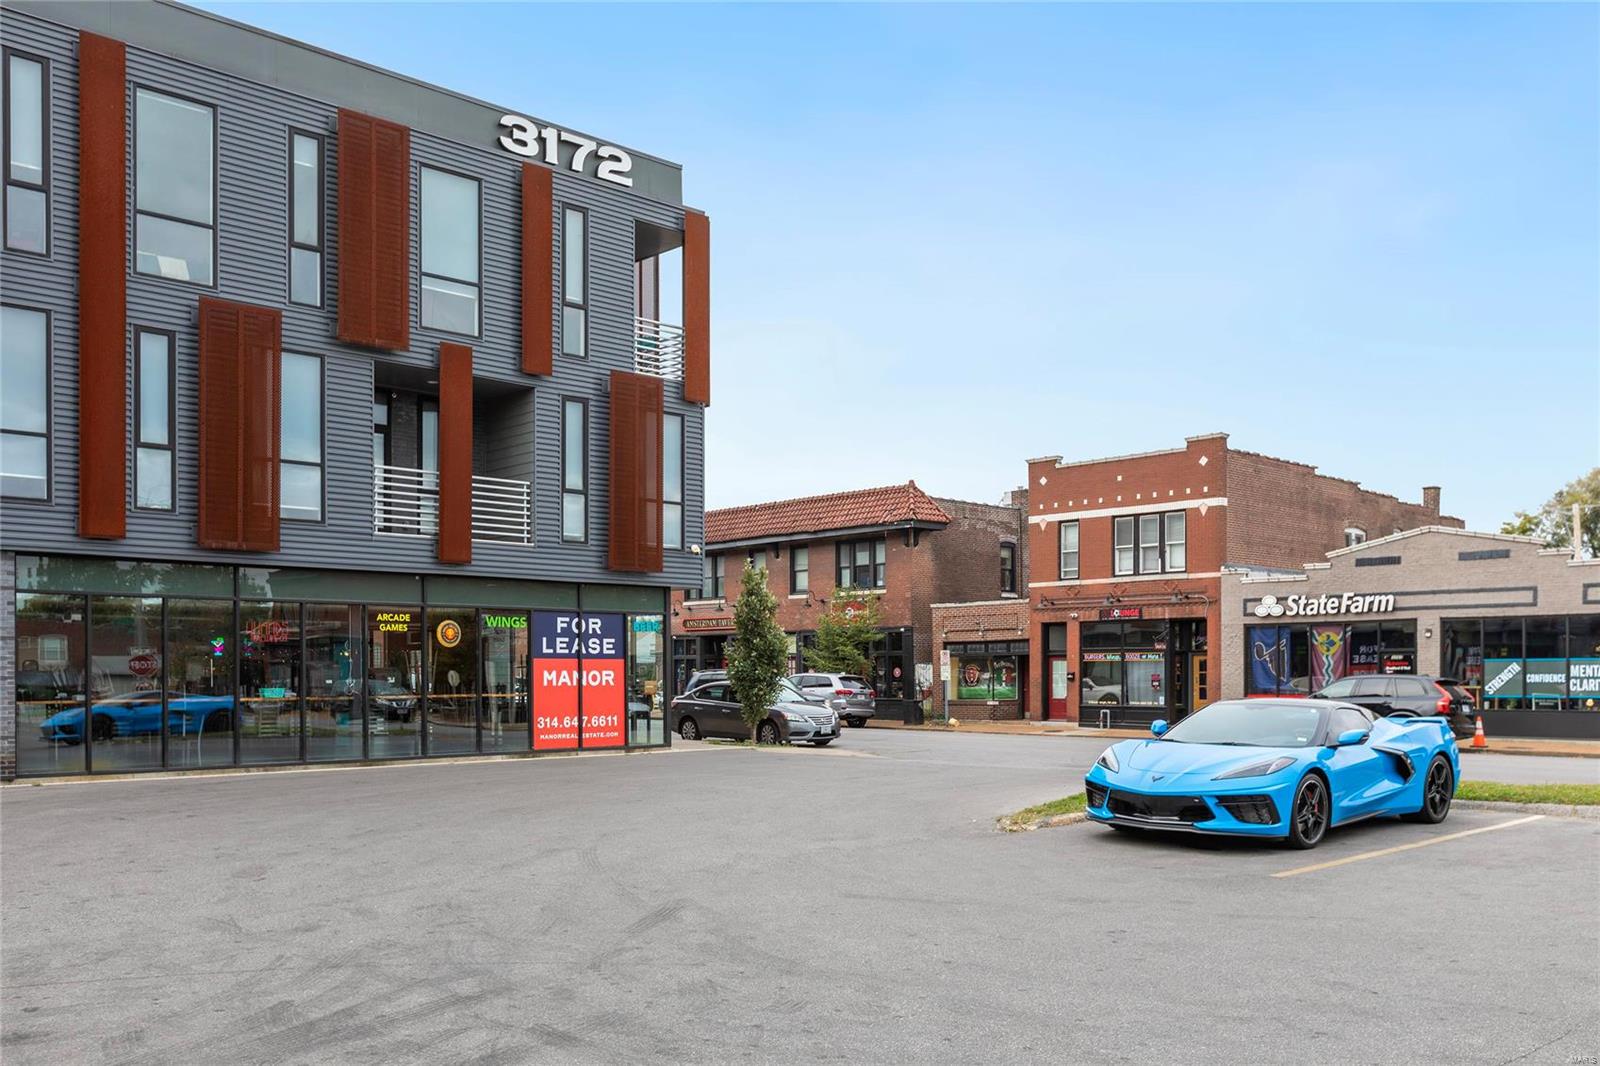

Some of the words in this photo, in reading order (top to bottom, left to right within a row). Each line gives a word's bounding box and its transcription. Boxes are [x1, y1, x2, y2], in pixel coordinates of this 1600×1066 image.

[499, 113, 633, 188] 3172
[376, 612, 411, 622] ARCADE
[485, 614, 528, 628] WINGS
[717, 617, 737, 627] TAVER
[379, 623, 408, 632] GAMES
[556, 616, 603, 635] FOR
[542, 636, 616, 655] LEASE
[543, 669, 615, 687] MANOR
[1484, 661, 1522, 695] STRENGTH
[1570, 664, 1600, 678] MENT
[1526, 673, 1567, 684] CONFIDENCE
[537, 714, 619, 729] 314.647.6611
